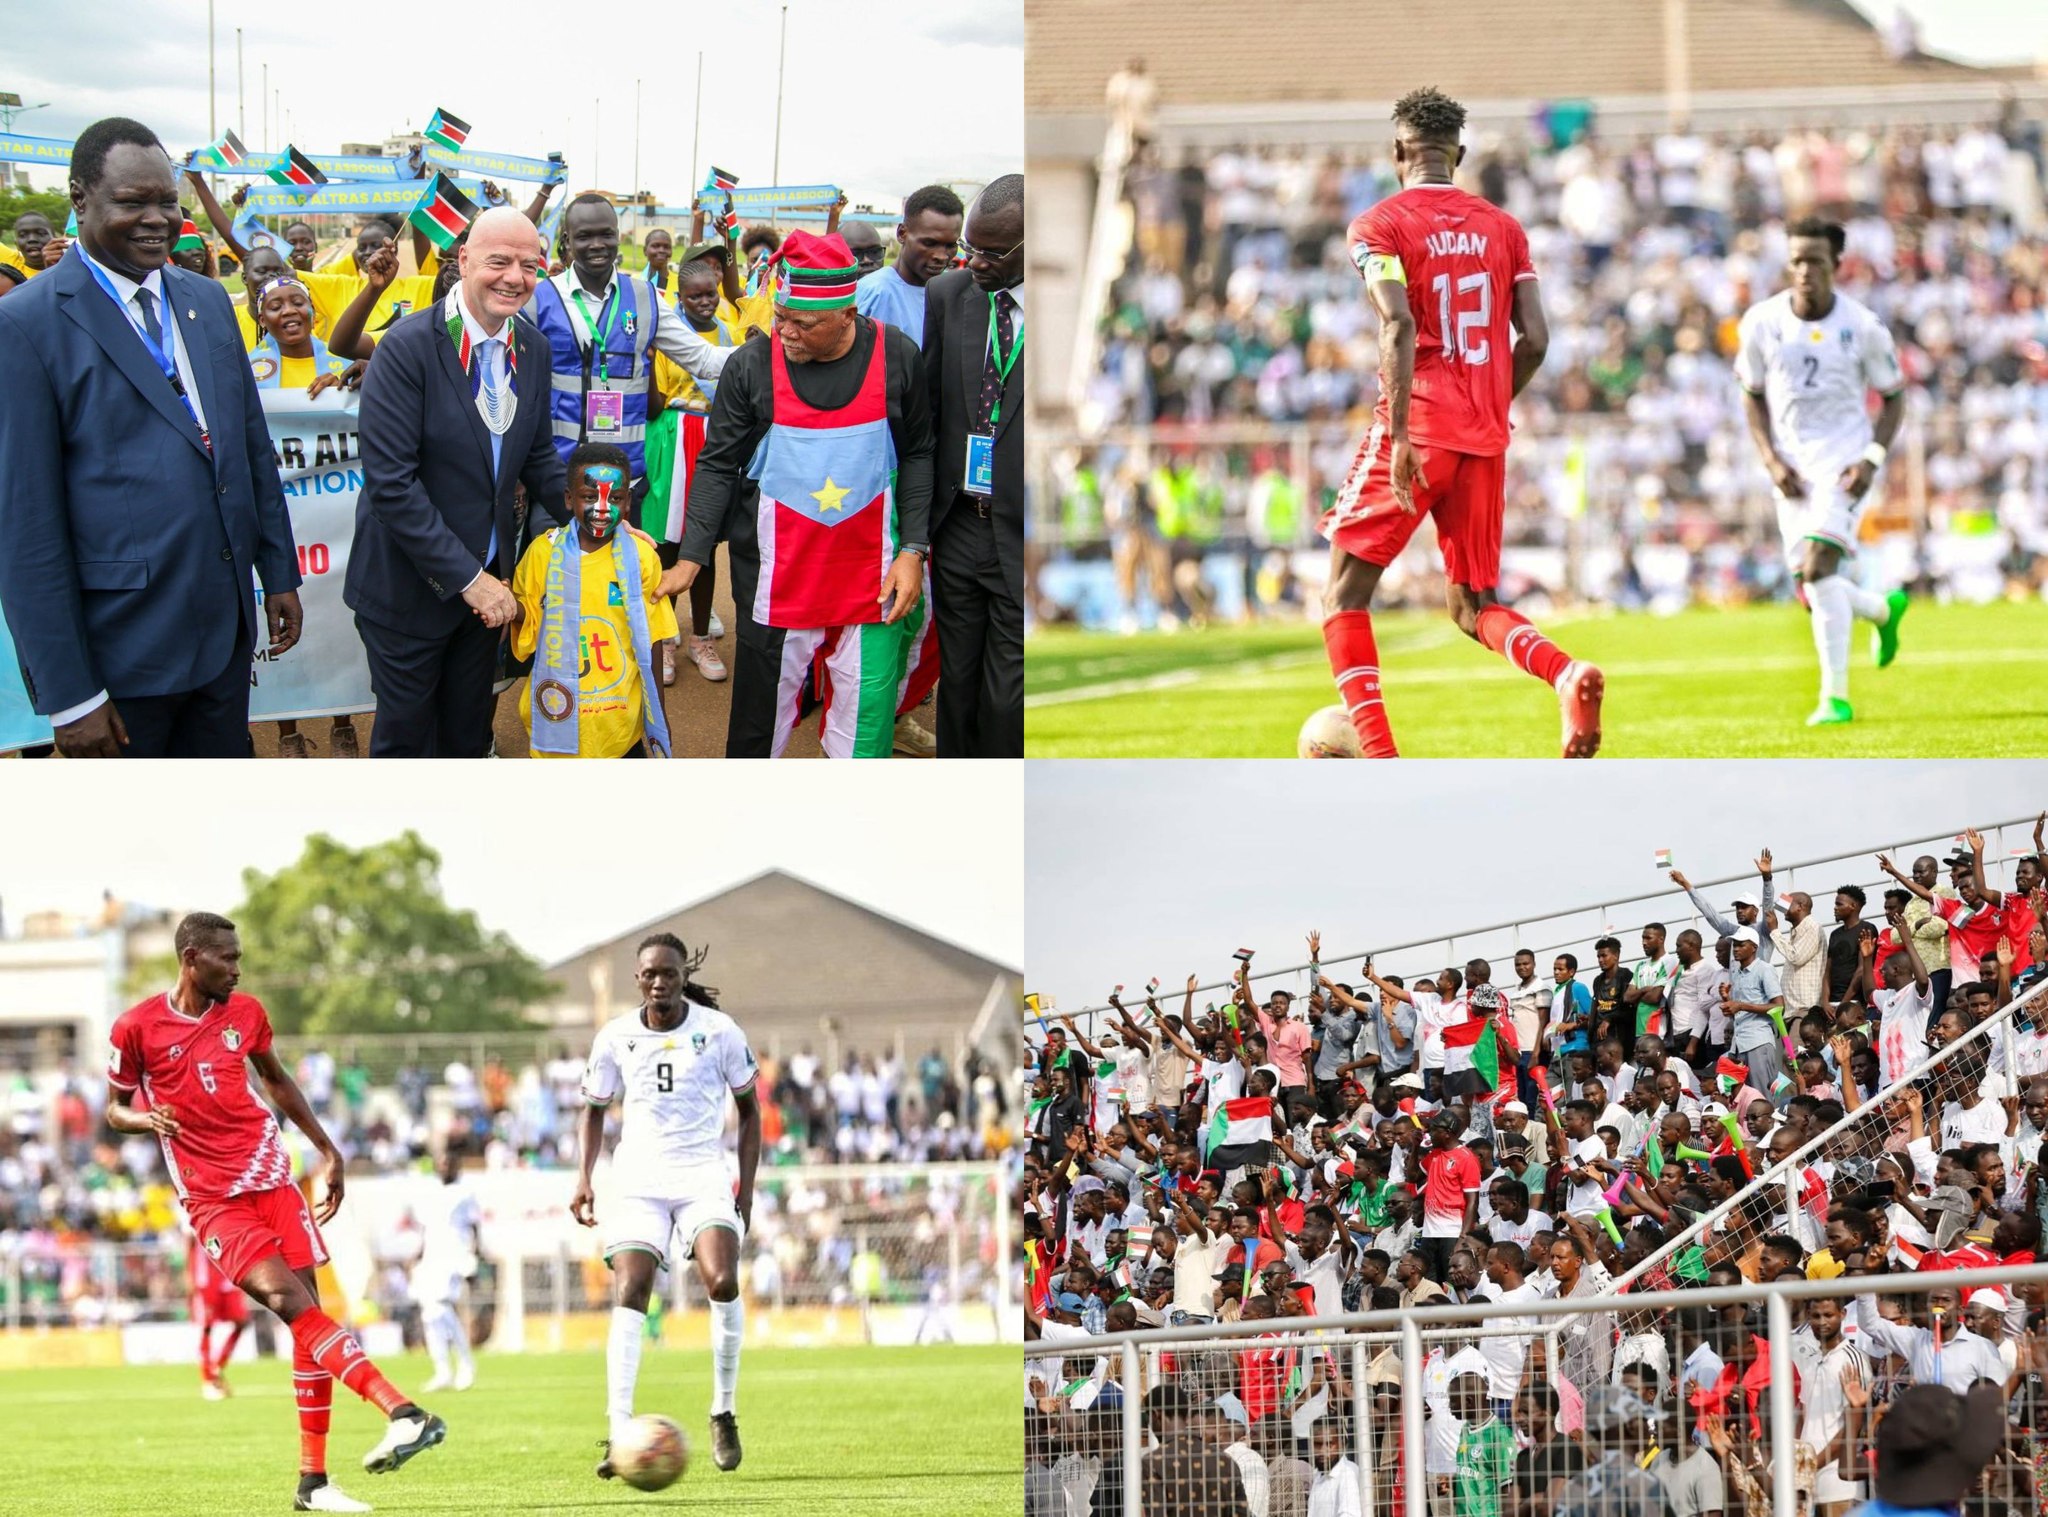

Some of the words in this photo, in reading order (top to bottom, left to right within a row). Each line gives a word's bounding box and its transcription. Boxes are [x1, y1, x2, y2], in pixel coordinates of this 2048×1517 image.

[267, 193, 308, 206] STAR
[311, 190, 368, 206] ALTRAS
[1426, 230, 1488, 260] SUDAN
[1432, 271, 1491, 366] 12
[1803, 354, 1819, 388] 2
[656, 1062, 674, 1093] 9
